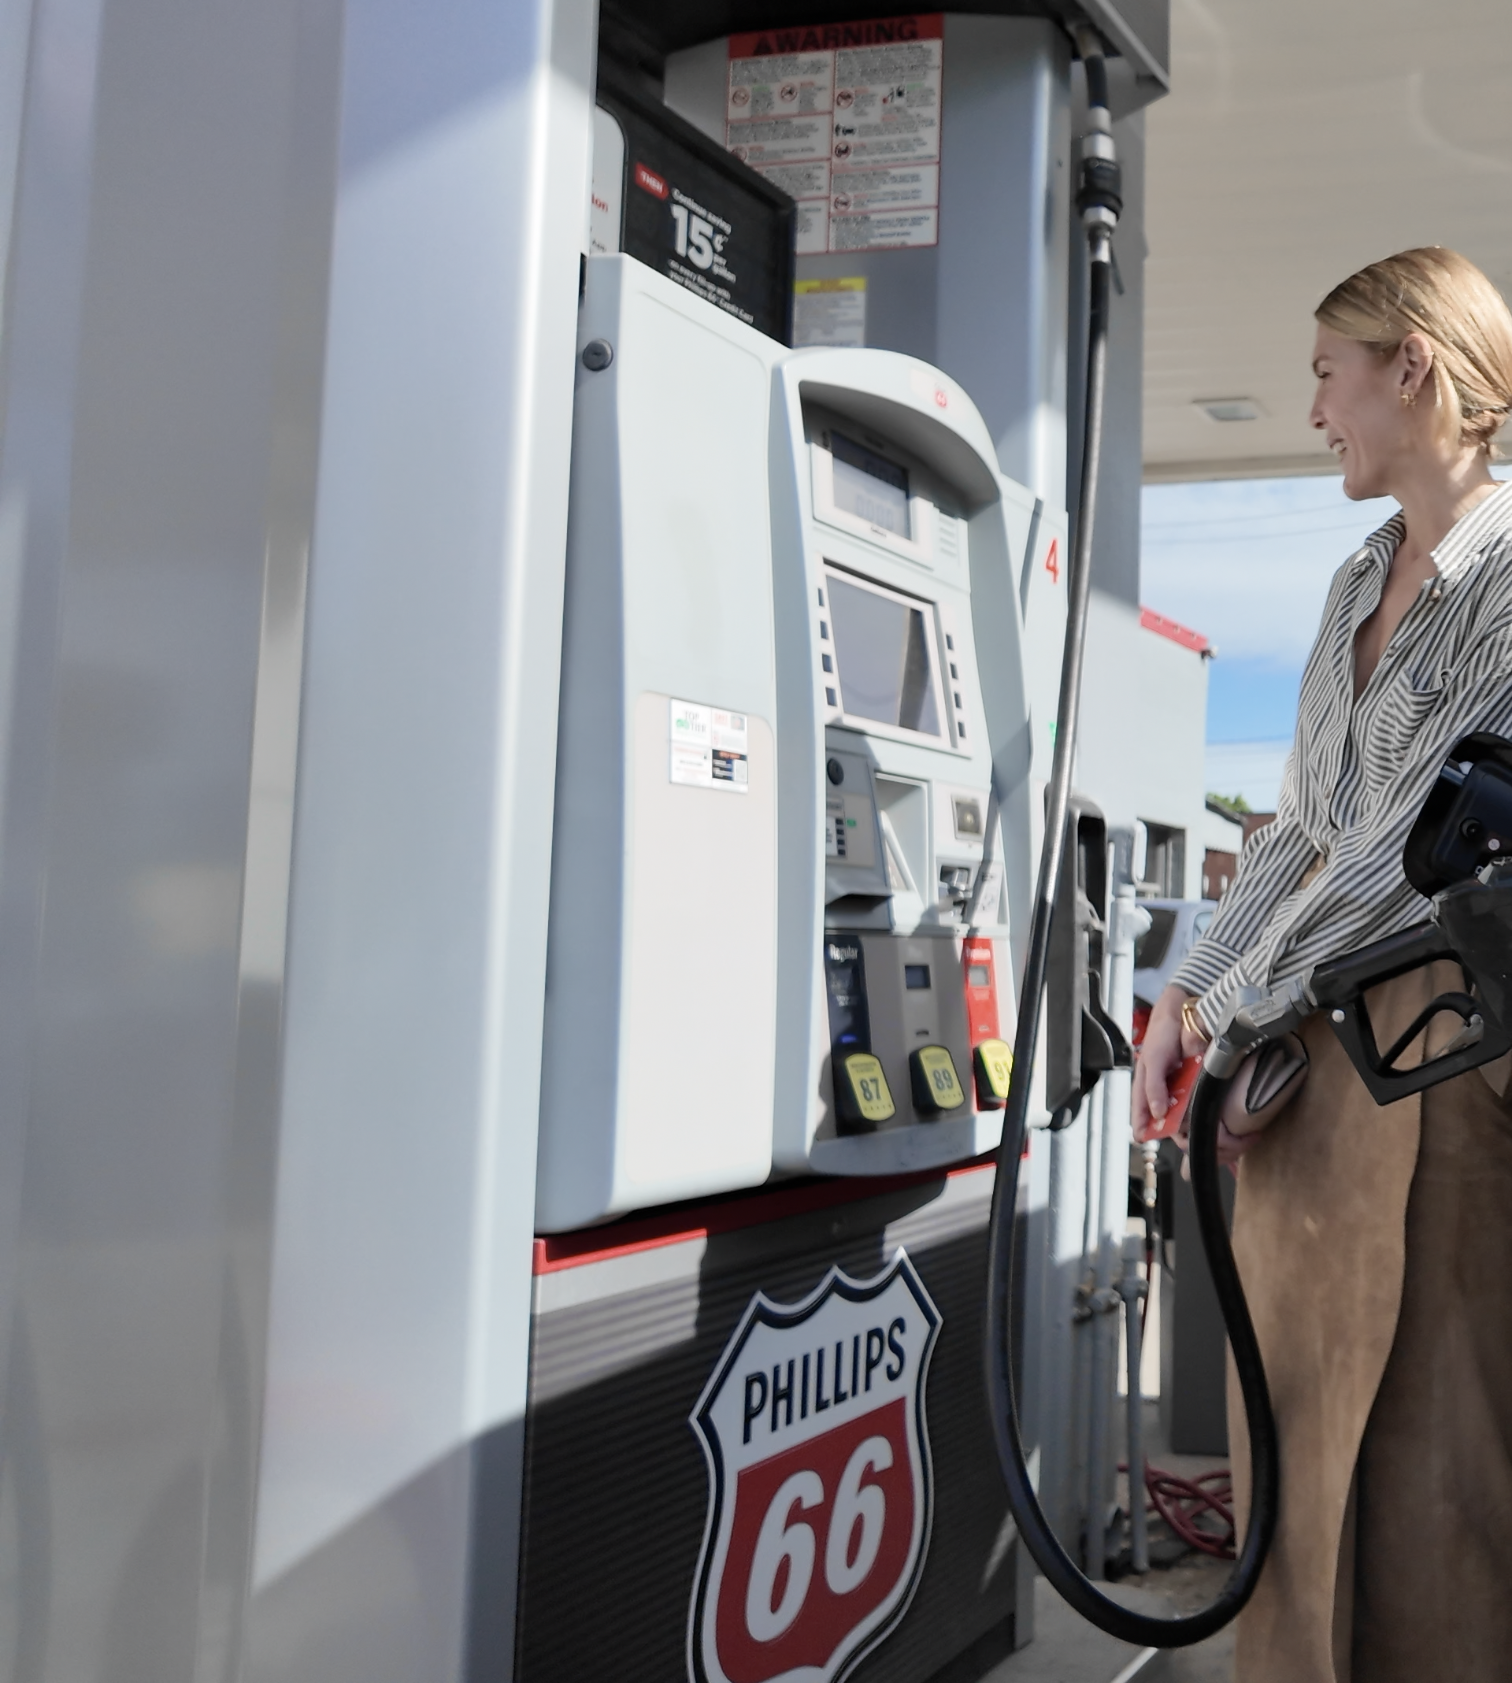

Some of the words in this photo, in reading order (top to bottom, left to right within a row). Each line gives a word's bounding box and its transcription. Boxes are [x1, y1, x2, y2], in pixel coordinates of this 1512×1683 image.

[776, 17, 918, 53] WARNING
[640, 170, 664, 194] THEN
[1046, 538, 1059, 584] 4
[829, 943, 859, 962] Regular
[860, 1077, 881, 1102] 87
[933, 1069, 954, 1091] 89
[742, 1316, 908, 1446] PHILLIPS
[744, 1434, 895, 1644] 66
